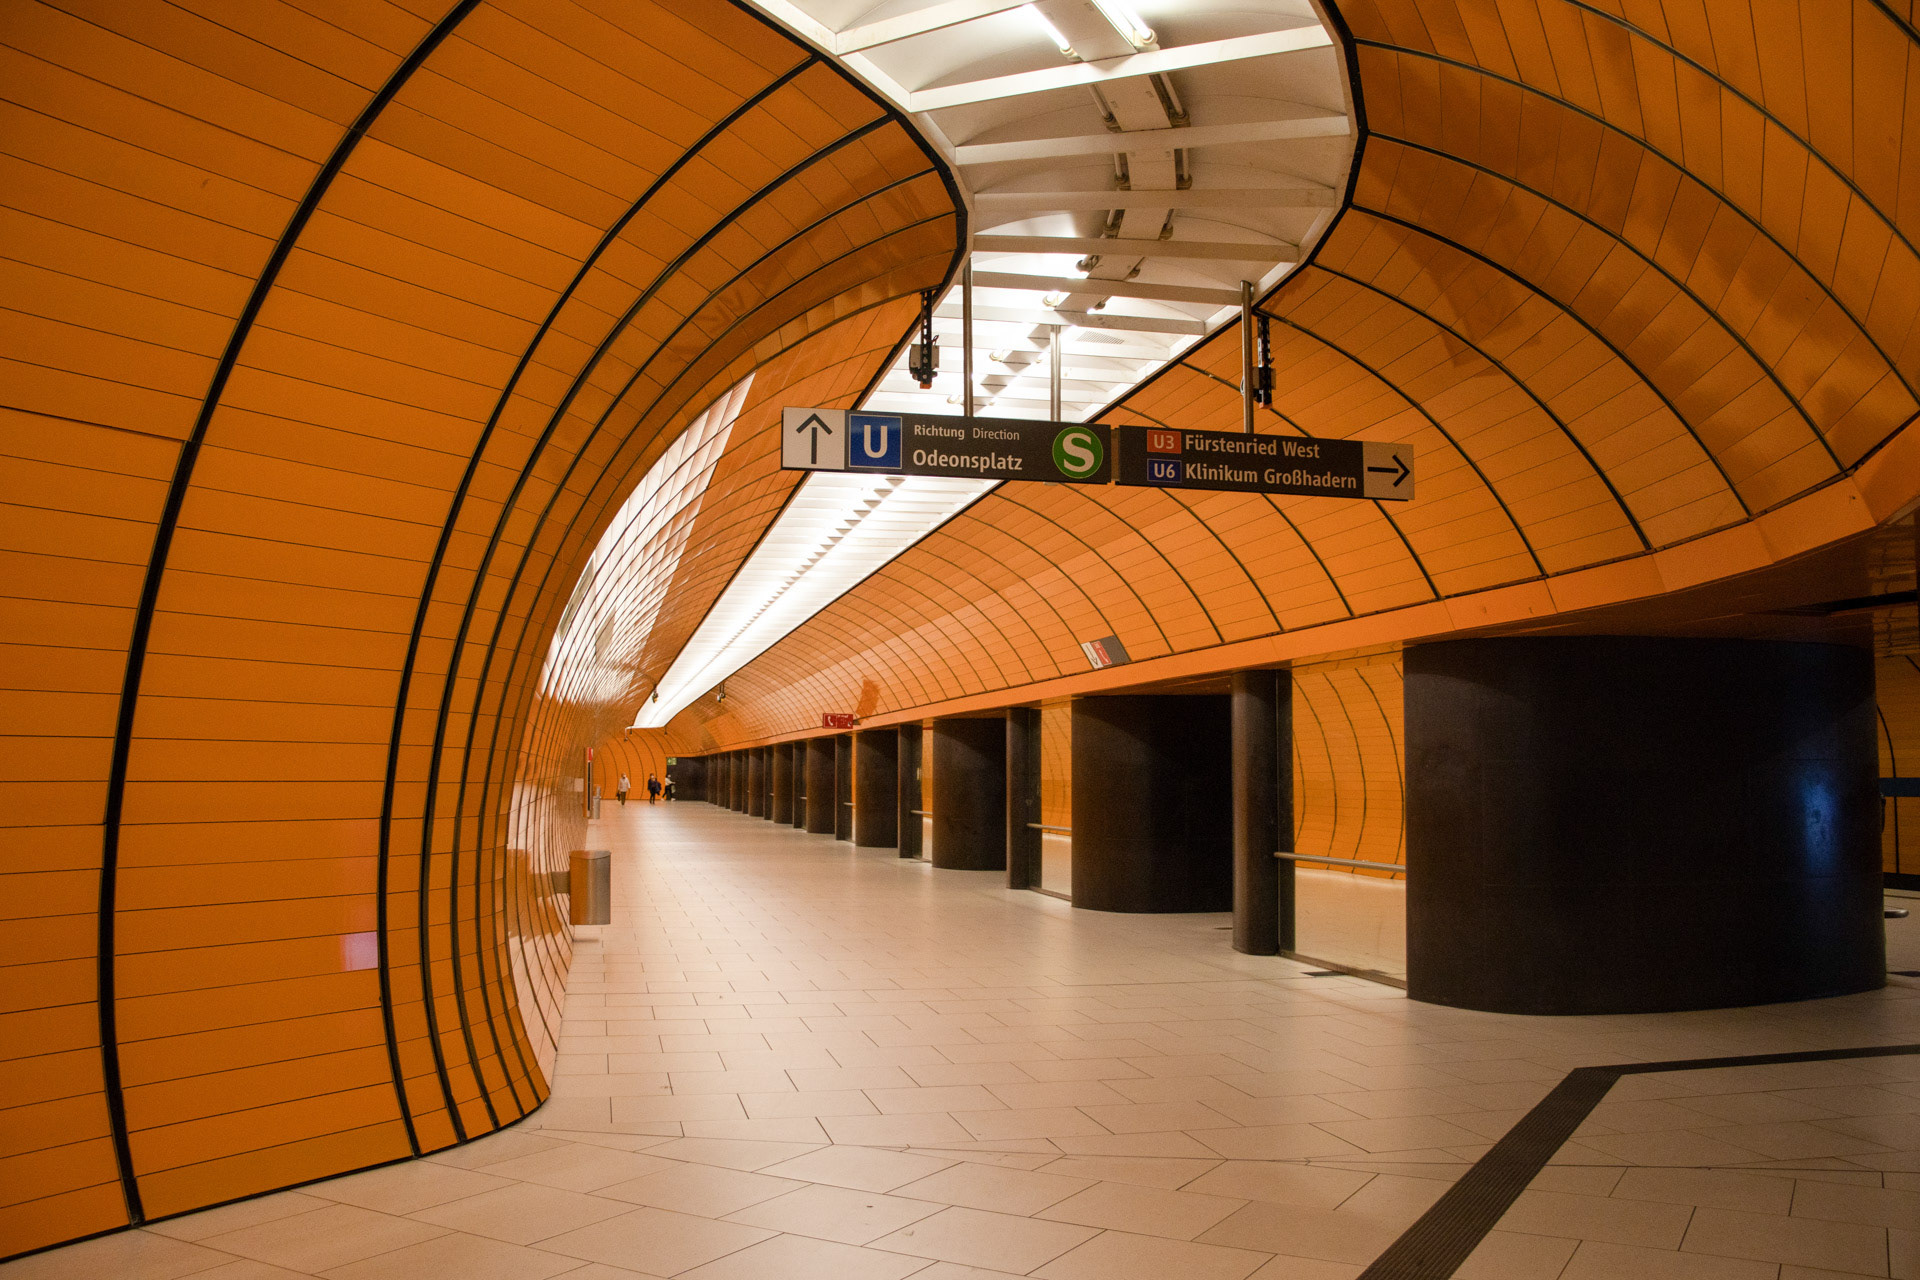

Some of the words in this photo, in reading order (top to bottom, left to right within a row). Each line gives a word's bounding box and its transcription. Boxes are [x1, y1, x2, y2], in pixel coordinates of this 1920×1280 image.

[863, 424, 888, 459] U
[913, 424, 965, 441] Richtung
[972, 427, 1020, 441] Direction
[1153, 432, 1175, 450] U3
[1185, 434, 1277, 456] Fürstenried
[1282, 440, 1320, 459] West
[912, 449, 1023, 473] Odeonsplatz
[1061, 432, 1096, 474] S
[1153, 460, 1176, 478] U6
[1185, 463, 1258, 483] Klinikum
[1264, 468, 1357, 489] Großhadern
